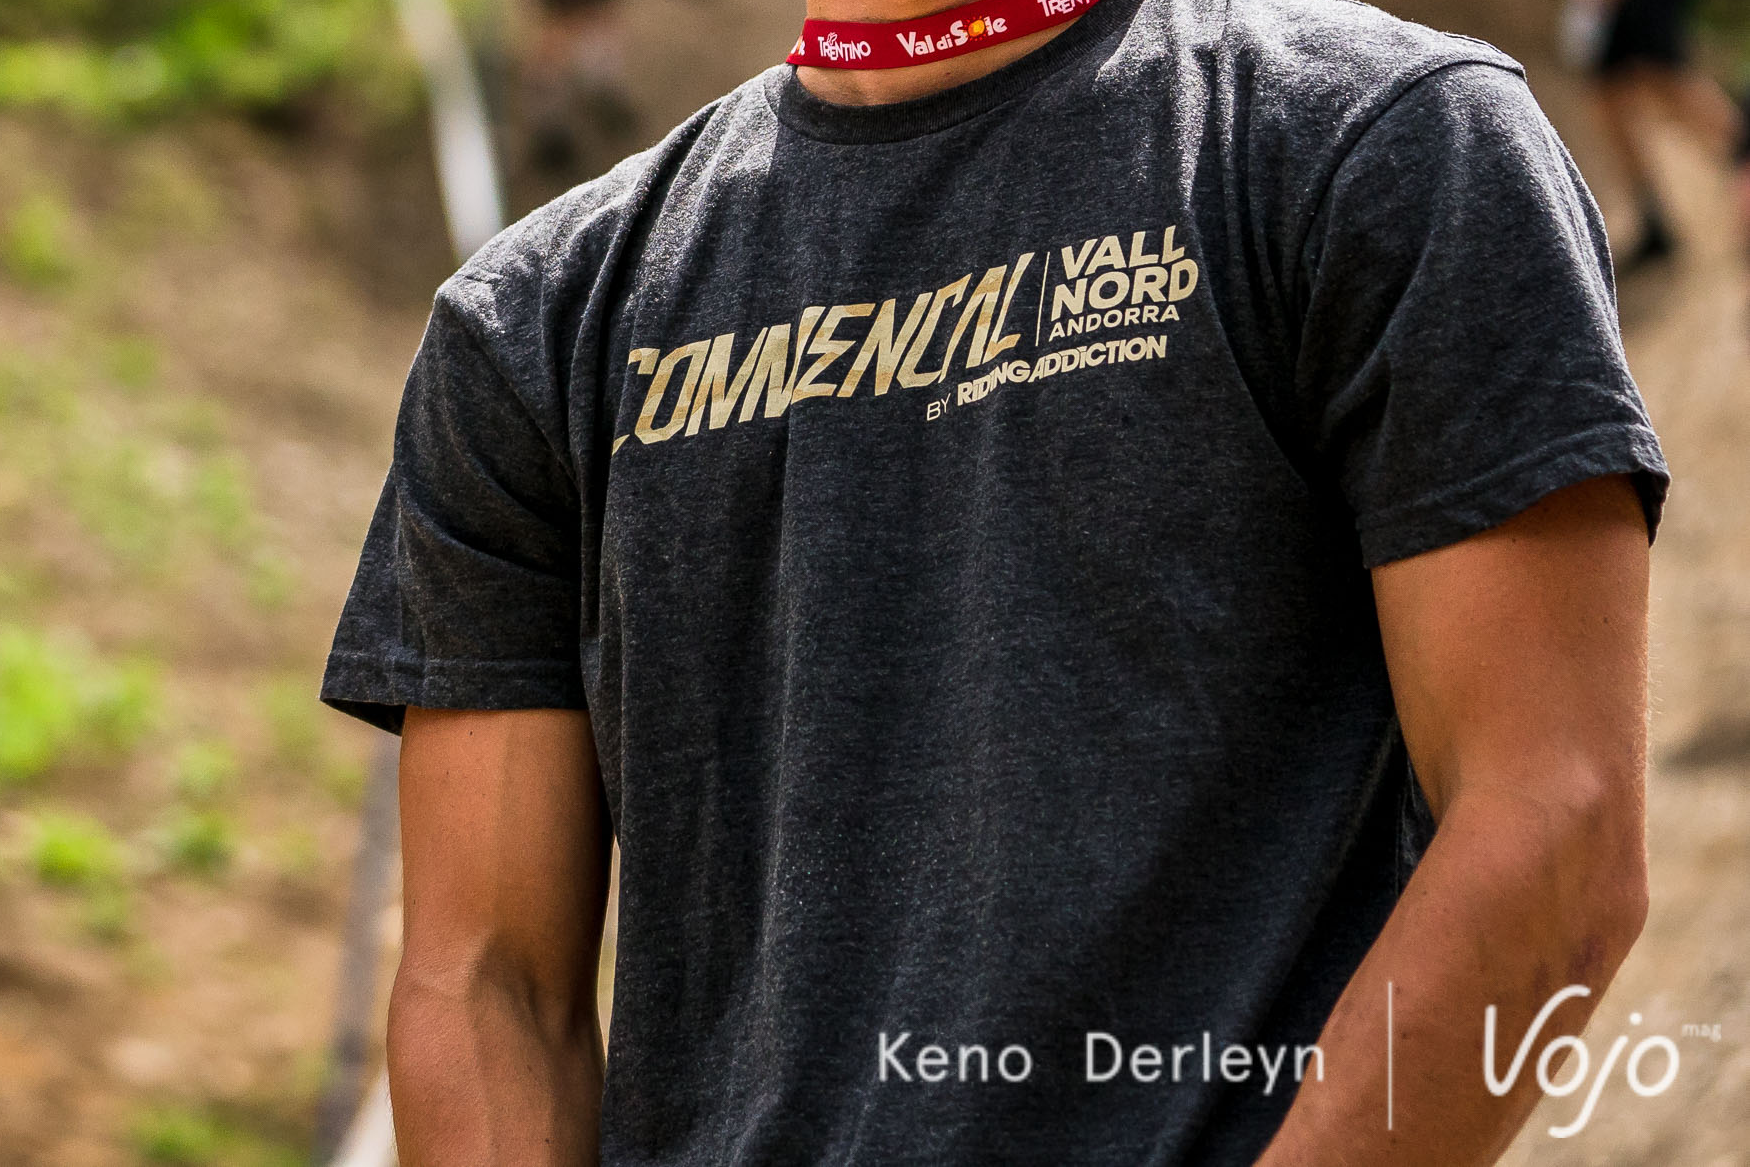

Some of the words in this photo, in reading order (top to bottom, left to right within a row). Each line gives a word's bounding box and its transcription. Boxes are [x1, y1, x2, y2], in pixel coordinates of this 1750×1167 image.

[818, 34, 872, 62] TRENTINO
[896, 30, 936, 59] Val
[936, 33, 954, 51] di
[950, 14, 1008, 47] Sole
[1061, 225, 1186, 281] VALL
[1051, 258, 1199, 322] NORD
[1049, 304, 1180, 342] ANDORRA
[926, 393, 952, 422] BY
